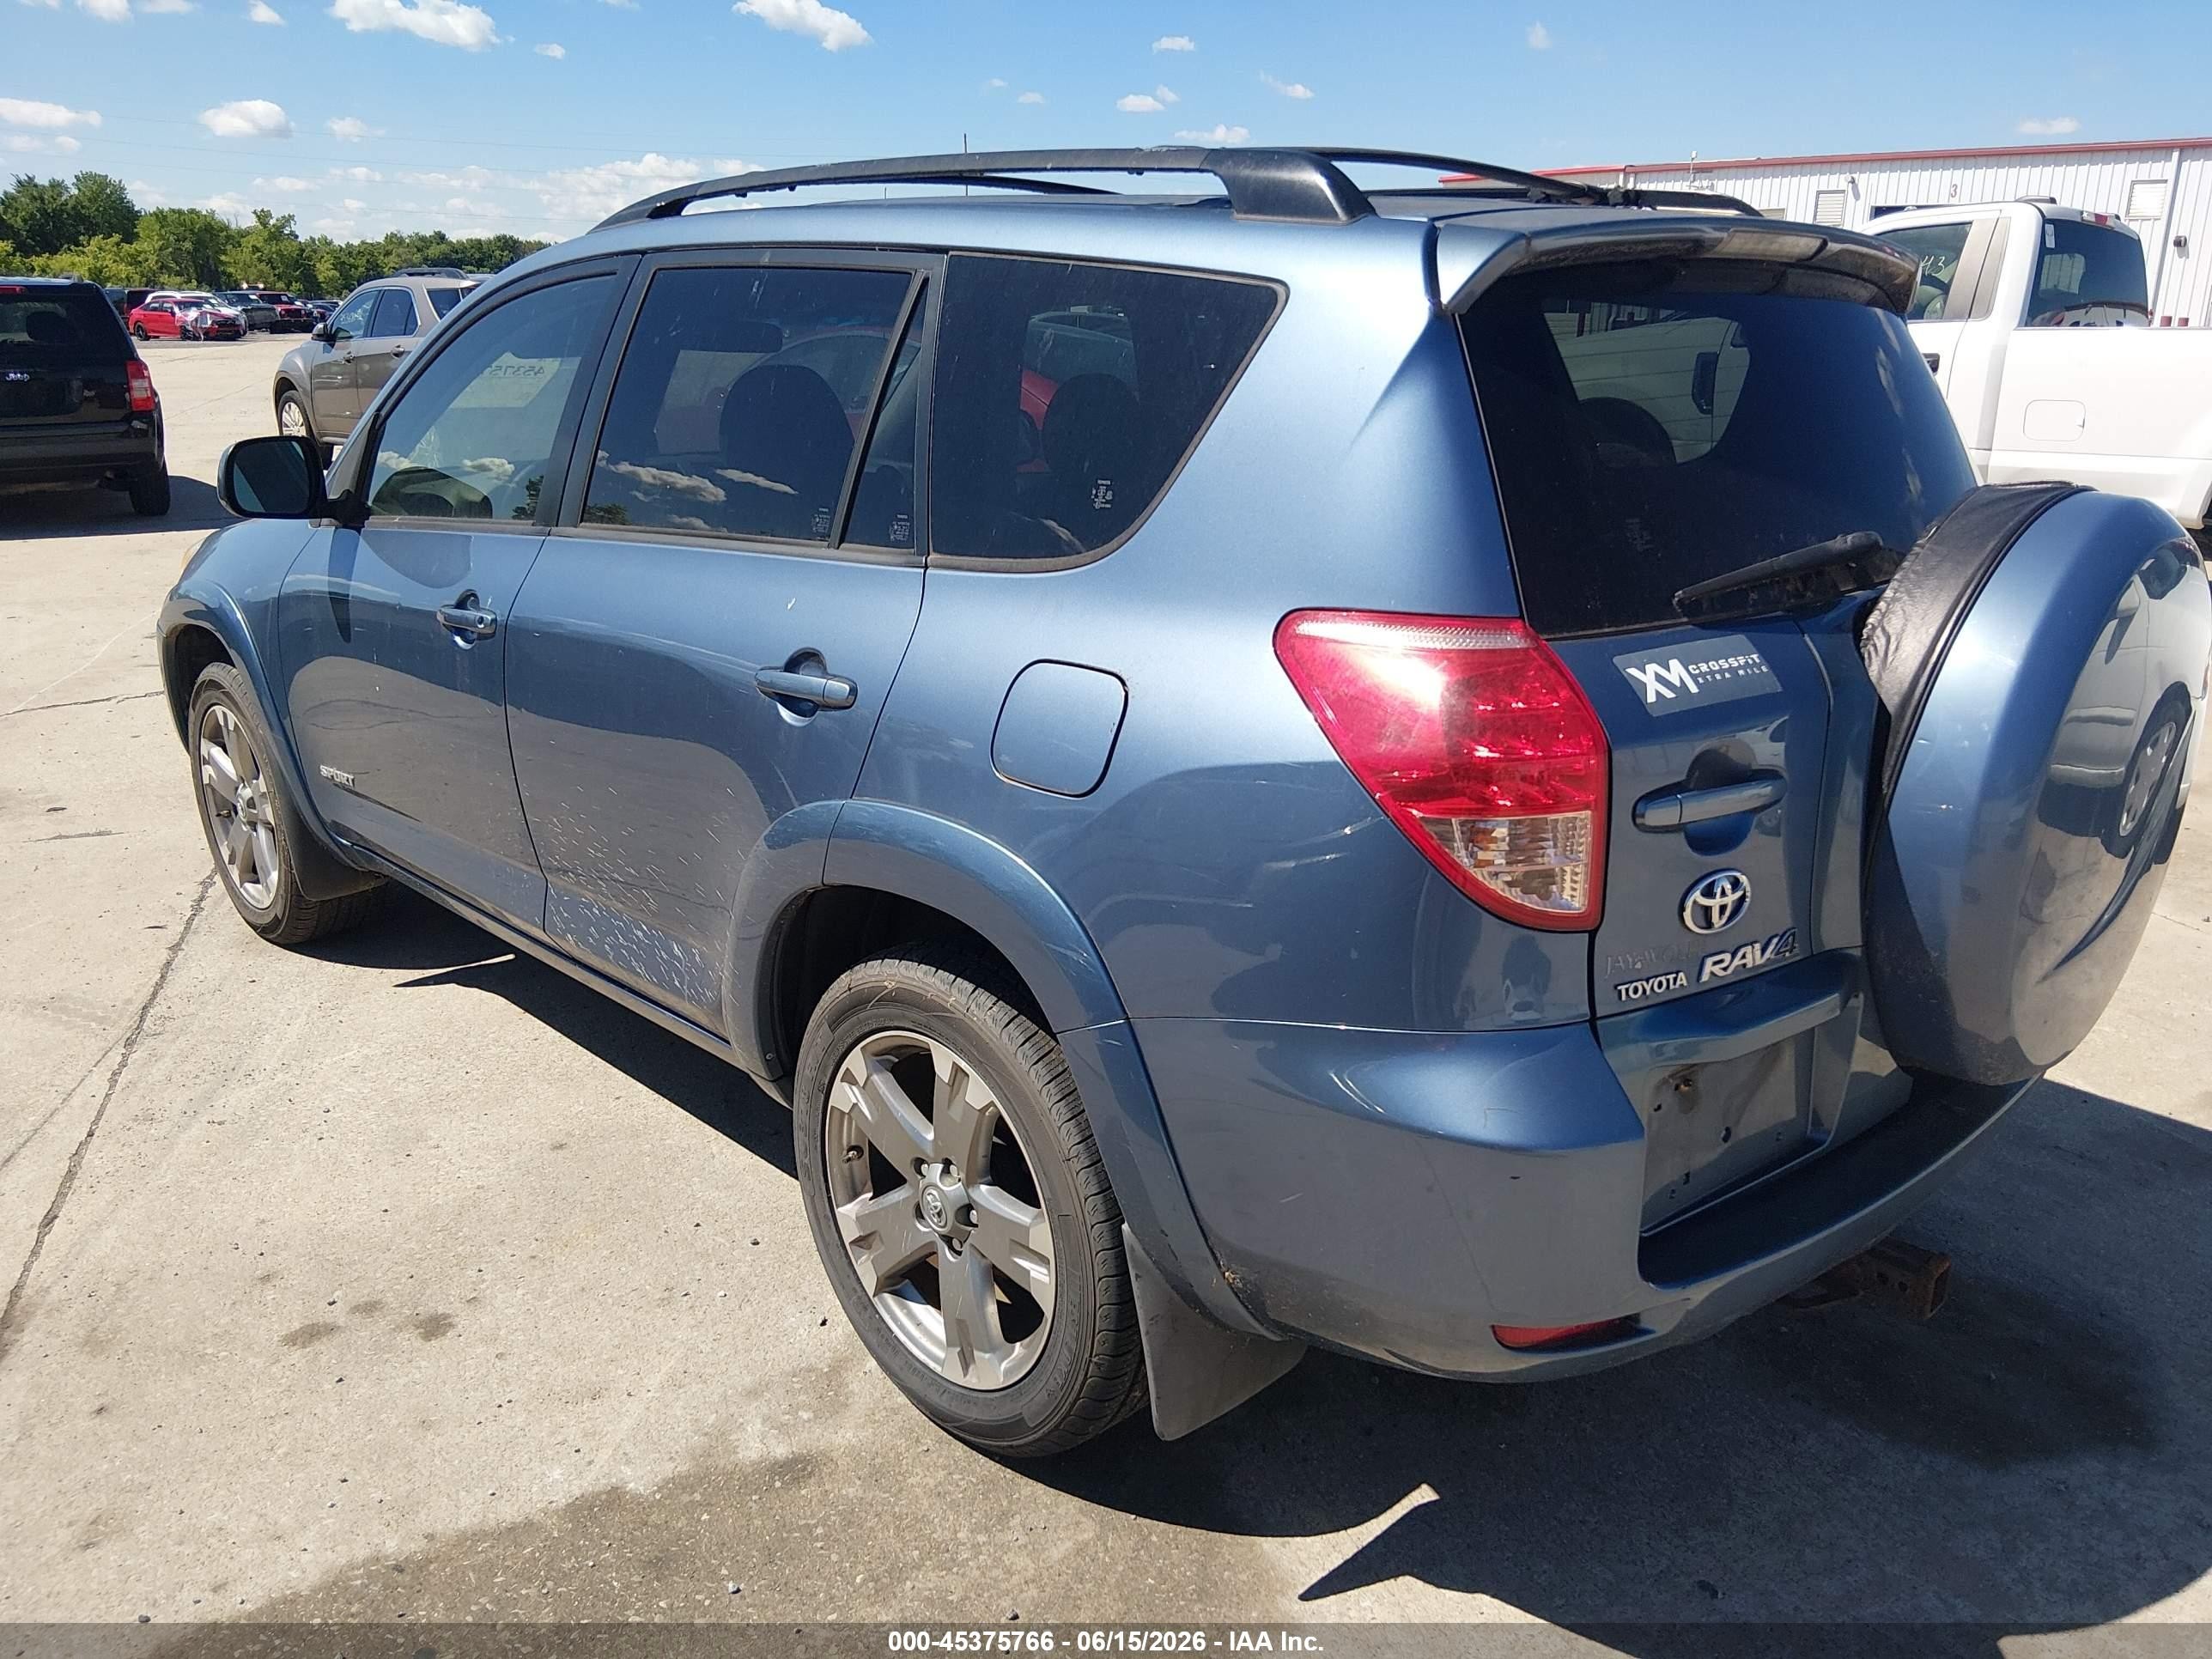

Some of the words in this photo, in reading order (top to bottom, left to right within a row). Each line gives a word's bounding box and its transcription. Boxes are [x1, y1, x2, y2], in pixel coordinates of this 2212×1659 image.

[1950, 183, 1958, 198] 3
[5, 373, 31, 382] Jeep
[1624, 658, 1700, 704] XM
[319, 764, 356, 787] SPORT
[1615, 970, 1689, 1001] TOYOTA
[1698, 927, 1801, 983] RAV4
